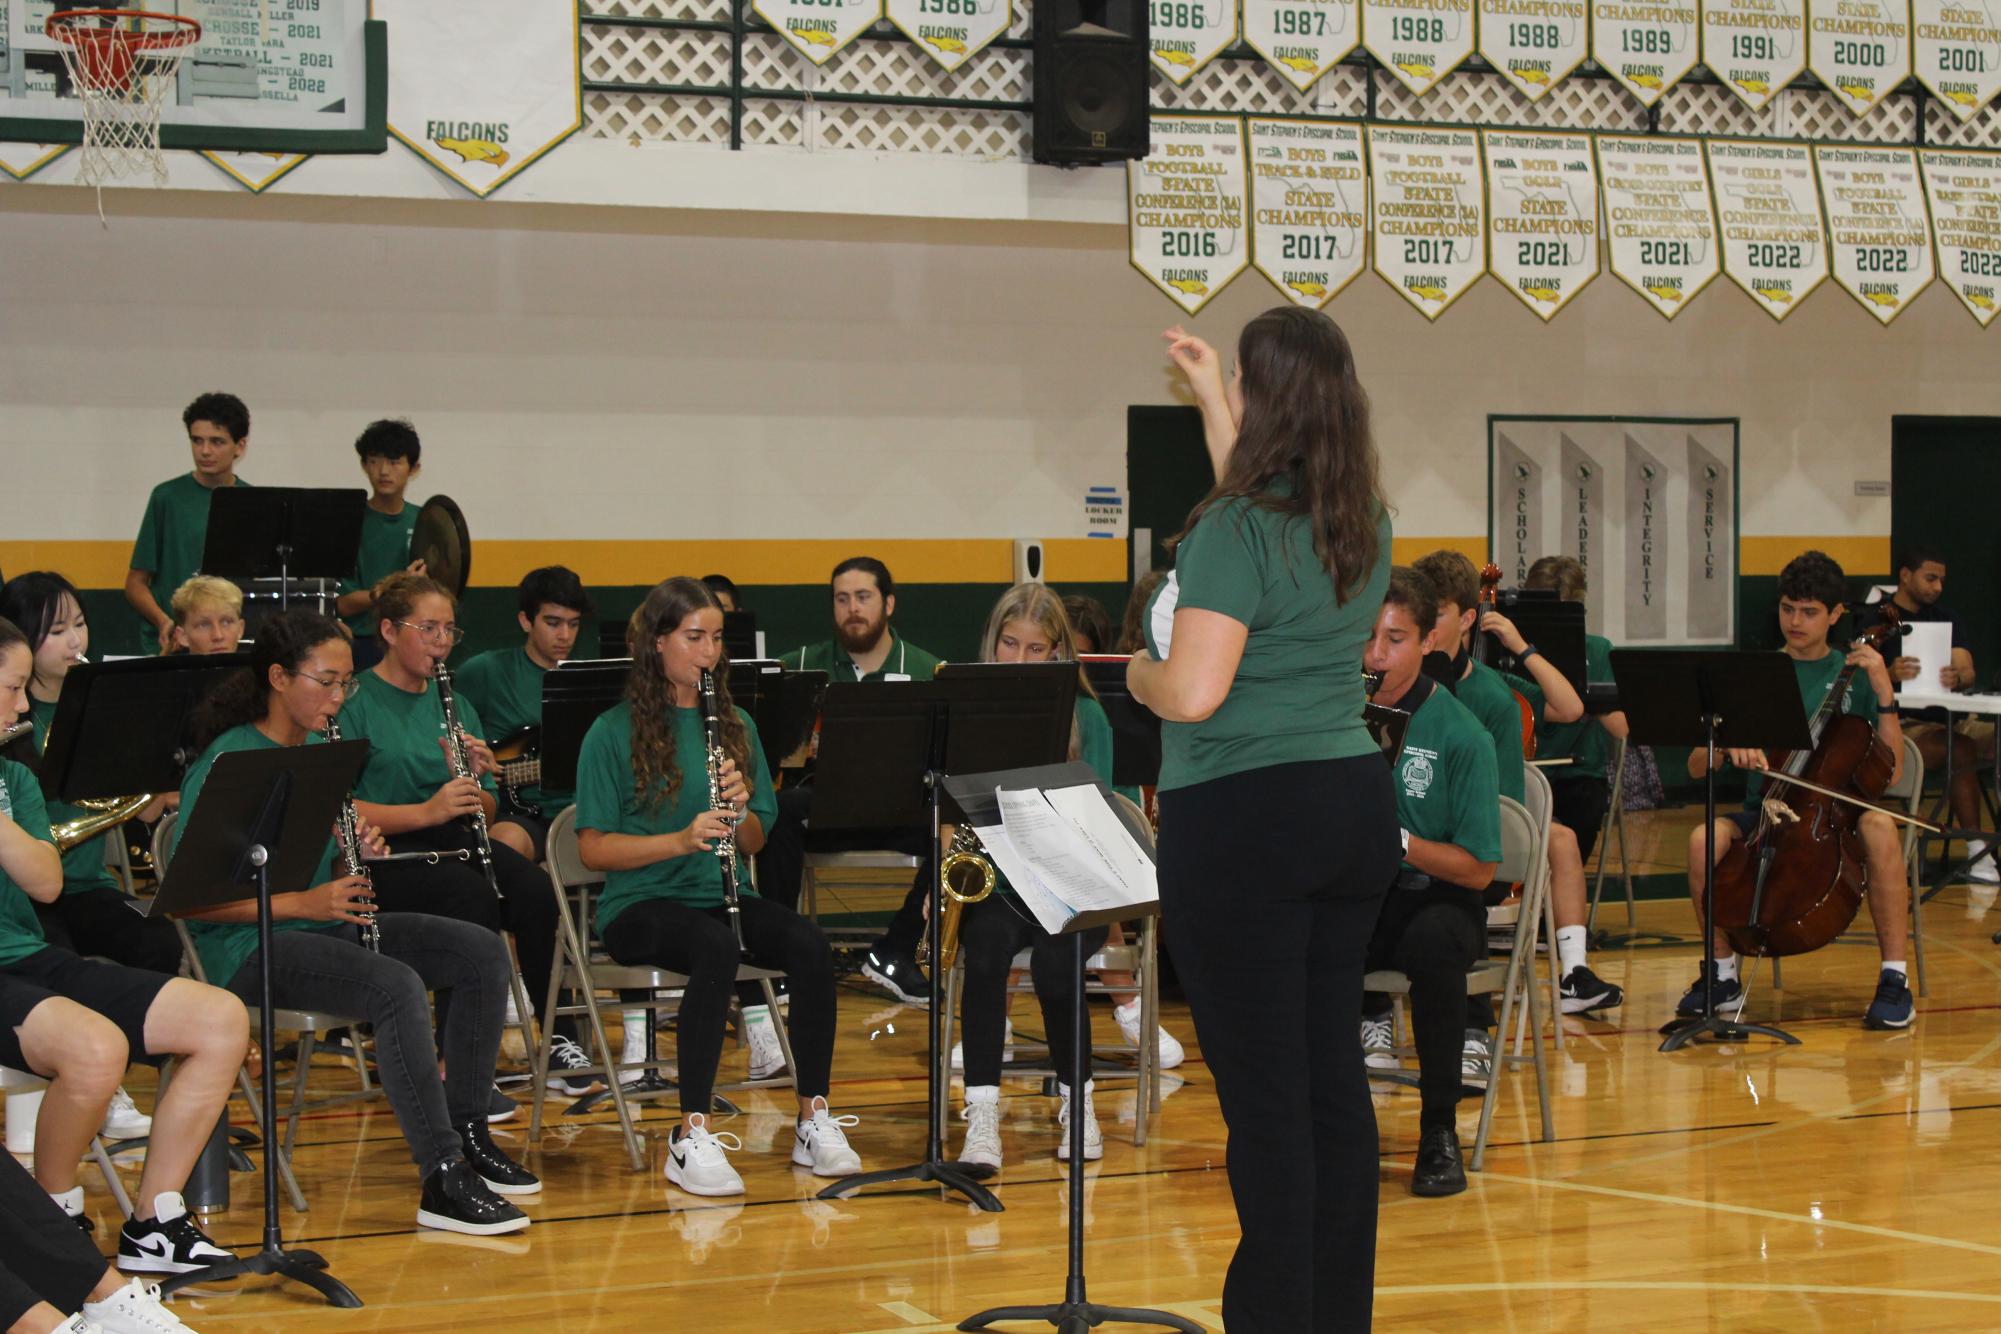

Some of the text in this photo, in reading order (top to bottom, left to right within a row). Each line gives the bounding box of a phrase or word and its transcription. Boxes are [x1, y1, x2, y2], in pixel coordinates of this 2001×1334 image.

[919, 0, 977, 15] 1986
[1481, 0, 1583, 17] CHAMPIONS
[1595, 5, 1695, 24] CHAMPIONS
[1837, 2, 1881, 18] STATE
[1151, 3, 1205, 29] 1986
[1273, 10, 1327, 36] 1987
[1705, 11, 1801, 30] CHAMPIONS
[1940, 9, 1984, 25] STATE
[288, 24, 321, 39] 2021
[786, 17, 837, 33] FALCONS
[918, 25, 968, 40] FALCONS
[1392, 16, 1443, 43] 1988
[1812, 18, 1905, 38] CHAMPIONS
[1509, 23, 1559, 48] 1988
[1622, 28, 1671, 54] 1989
[1917, 24, 2001, 44] CHAMPION
[1151, 39, 1196, 53] FALCONS
[1273, 46, 1319, 60] FALCONS
[1732, 34, 1775, 60] 1991
[299, 52, 333, 68] 2021
[1391, 52, 1436, 66] FALCONS
[1834, 41, 1885, 67] 2000
[1939, 48, 1985, 73] 2001
[1508, 59, 1551, 72] FALCONS
[1621, 64, 1664, 77] FALCONS
[1729, 70, 1770, 82] FALCONS
[1835, 75, 1875, 89] FALCONS
[288, 78, 326, 93] 2022
[1938, 81, 1978, 94] FALCONS
[426, 120, 510, 143] FALCONS
[1150, 121, 1180, 133] TEPHEN'S
[1214, 122, 1237, 134] SCHOOL
[1335, 127, 1357, 140] SCHOOL
[1452, 134, 1473, 146] SCHOOL
[1566, 138, 1587, 151] SCHOOL
[1165, 144, 1205, 157] BOYS
[1287, 148, 1326, 161] BOYS
[1147, 161, 1227, 175] FOOTBALL
[1407, 155, 1443, 168] BOYS
[1256, 163, 1361, 181] TRACK & FIELD
[1390, 171, 1466, 185] FOOTBALL
[1852, 172, 1885, 184] BOYS
[1162, 178, 1215, 192] STATE
[1135, 194, 1217, 209] CONFERENCE
[1285, 191, 1335, 207] STATE
[1404, 187, 1453, 202] STATE
[1634, 192, 1681, 207] STATE
[1379, 203, 1456, 219] CONFERENCE
[1520, 200, 1567, 216] STATE
[1744, 197, 1790, 212] STATE
[1851, 203, 1897, 216] STATE
[1136, 212, 1242, 229] CHAMPIONS
[1256, 209, 1362, 228] CHAMPIONS
[1612, 207, 1709, 223] CONFERENCE
[1379, 221, 1479, 238] CHAMPIONS
[1493, 217, 1594, 235] CHAMPIONS
[1614, 223, 1711, 239] CHAMPIONS
[1727, 228, 1820, 243] CHAMPIONS
[1836, 232, 1926, 247] CHAMPIONS
[1162, 231, 1216, 257] 2016
[1283, 234, 1336, 260] 2017
[1404, 239, 1454, 264] 2017
[1518, 241, 1568, 266] 2021
[1641, 241, 1690, 265] 2021
[1748, 244, 1801, 269] 2022
[1856, 248, 1907, 272] 2022
[1961, 250, 2001, 277] 2022
[1162, 269, 1208, 282] FALCONS
[1283, 271, 1328, 285] FALCONS
[1404, 275, 1447, 288] FALCONS
[1642, 276, 1683, 289] FALCONS
[1519, 277, 1561, 290] FALCONS
[1752, 278, 1791, 291] FALCONS
[1860, 282, 1898, 295] FALCONS
[1963, 284, 1994, 298] FALCONS
[1704, 488, 1713, 580] SERVICE
[1642, 488, 1652, 606] INTEGRITY
